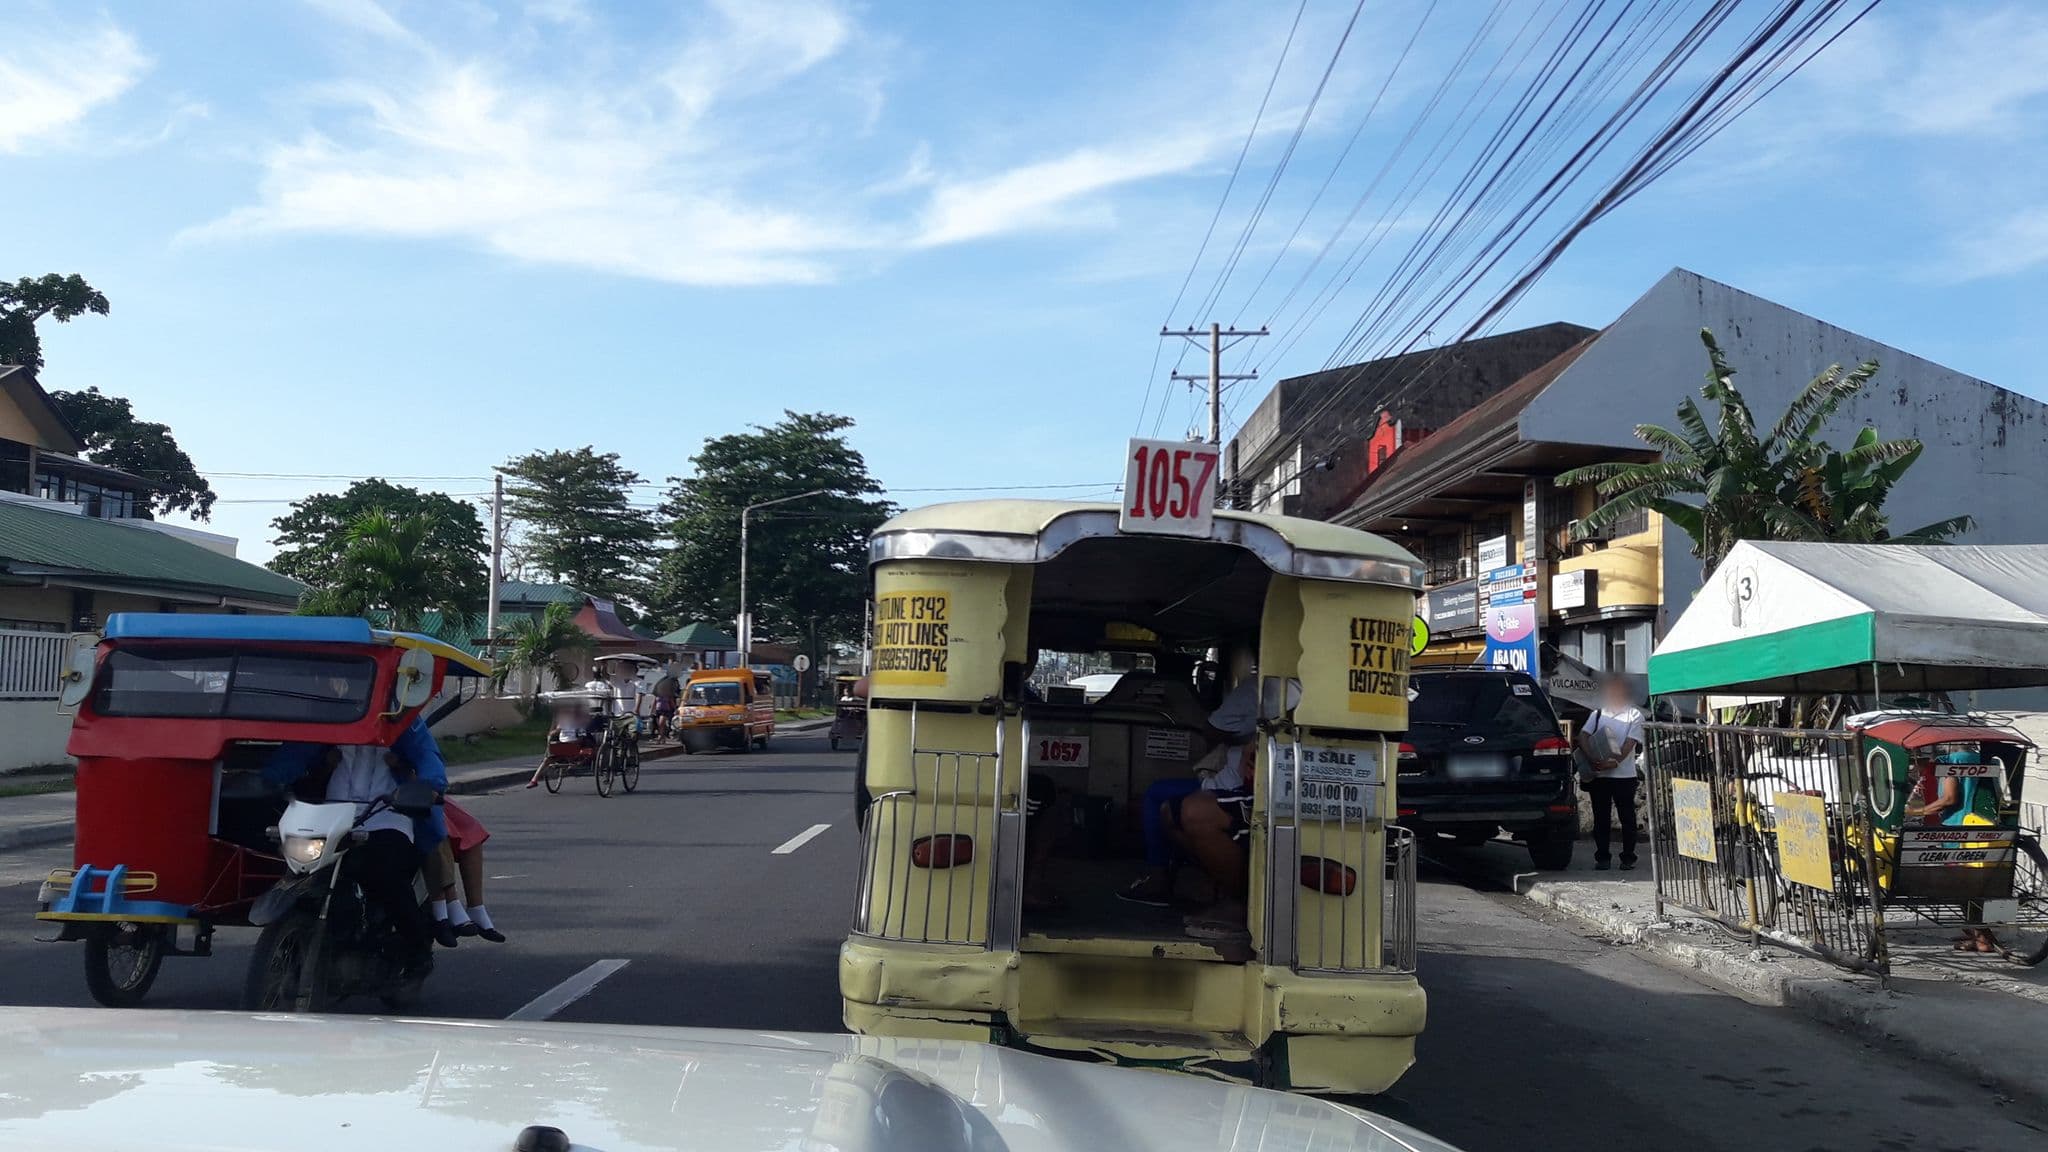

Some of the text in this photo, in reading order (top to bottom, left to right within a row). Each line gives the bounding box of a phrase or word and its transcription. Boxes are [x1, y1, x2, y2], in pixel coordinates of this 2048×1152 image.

[1130, 446, 1218, 519] 1057
[1740, 577, 1752, 601] 3
[911, 597, 945, 620] 1342
[886, 623, 948, 647] HOTLINES
[1350, 643, 1388, 669] TXT
[1040, 739, 1082, 762] 1057
[1284, 748, 1356, 766] FR SALE
[1311, 765, 1353, 777] PASSENGER
[1354, 769, 1371, 778] JEEP
[1946, 766, 1988, 777] STOP
[1915, 831, 1969, 841] SABINADA
[1918, 851, 1949, 862] CLEAN
[1956, 851, 1988, 861] GREEN
